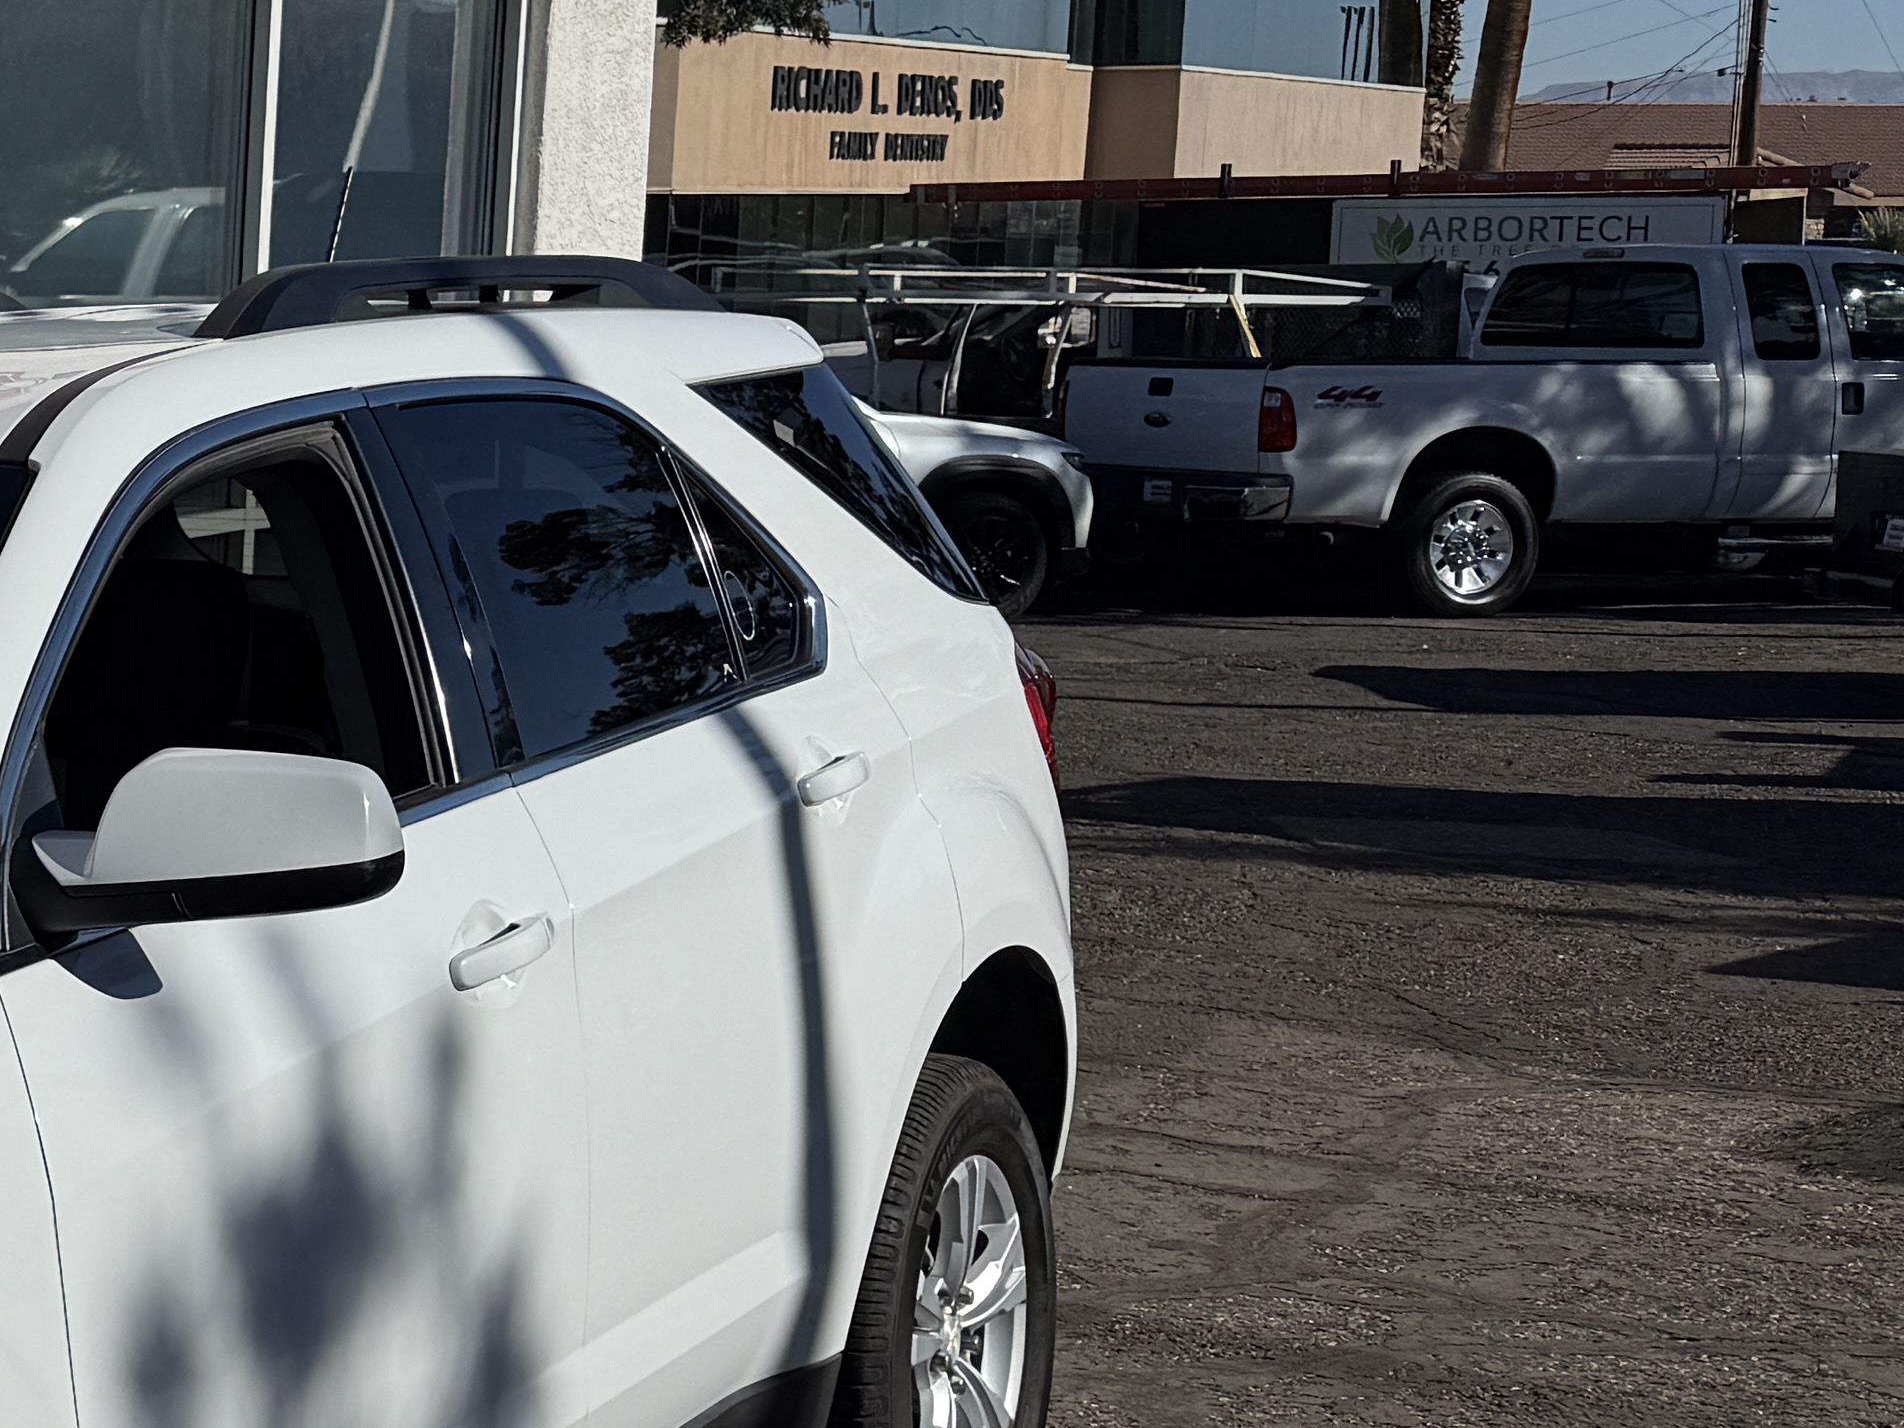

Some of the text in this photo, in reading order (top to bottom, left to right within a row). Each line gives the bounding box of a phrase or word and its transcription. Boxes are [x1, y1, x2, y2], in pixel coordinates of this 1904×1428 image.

[770, 65, 1005, 124] RICHARD L. DENOS, DDS
[829, 130, 950, 162] FAMILY DENTISTRY
[1418, 215, 1650, 243] ARBORTECH
[1419, 244, 1460, 257] THE
